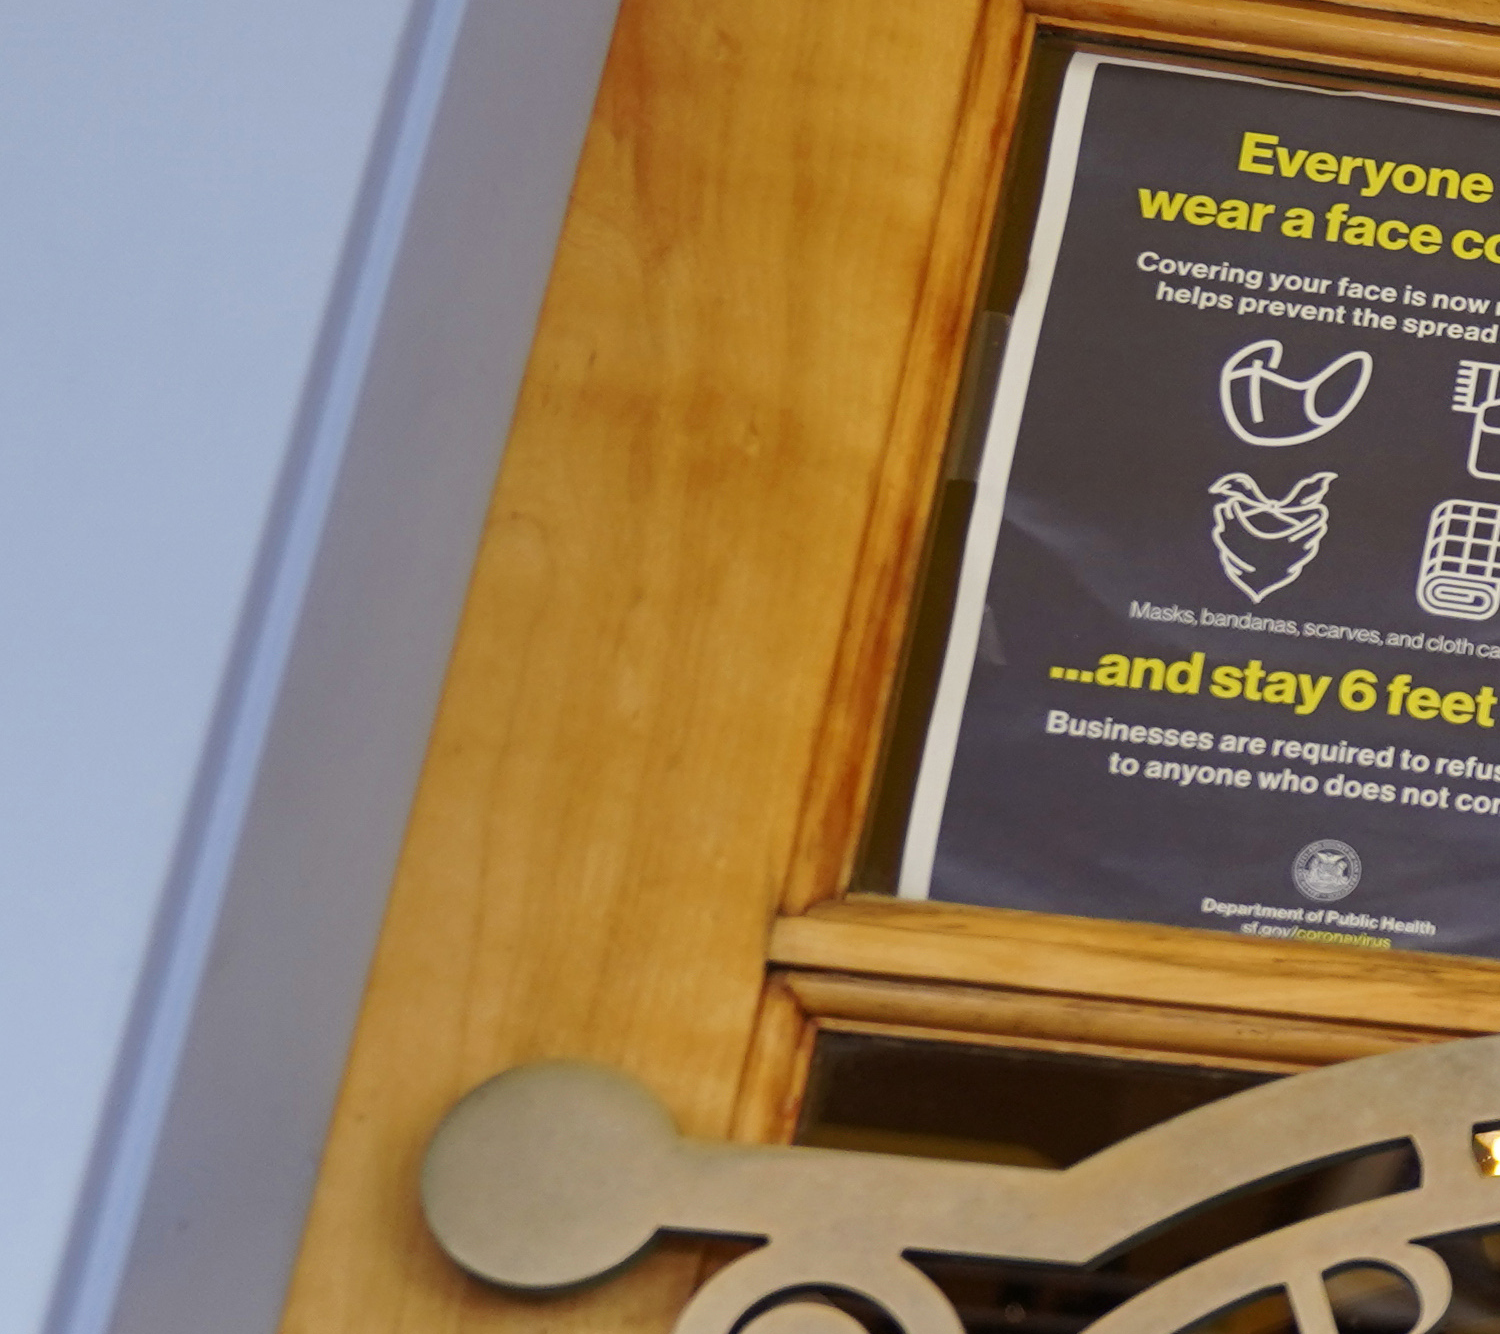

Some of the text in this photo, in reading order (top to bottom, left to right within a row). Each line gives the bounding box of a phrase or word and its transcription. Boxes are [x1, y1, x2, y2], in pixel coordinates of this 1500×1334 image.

[1237, 131, 1495, 204] Everyone
[1137, 187, 1277, 233] wear
[1280, 206, 1316, 240] a
[1324, 202, 1444, 255] face
[1136, 250, 1264, 290] Covering
[1267, 272, 1333, 295] your
[1337, 276, 1398, 304] face
[1402, 284, 1428, 308] is
[1431, 293, 1492, 315] now
[1155, 280, 1234, 310] helps
[1237, 296, 1347, 325] prevent
[1351, 307, 1398, 331] the
[1401, 317, 1500, 344] spread
[1128, 599, 1199, 627] Masks,
[1199, 607, 1301, 638] bandanas,
[1301, 621, 1385, 647] scarves,
[1384, 631, 1426, 650] and
[1424, 634, 1476, 656] cloth
[1049, 650, 1206, 695] ...and
[1208, 659, 1333, 716] stay
[1338, 668, 1379, 712] 6
[1386, 673, 1499, 728] feet
[1045, 709, 1215, 751] Businesses
[1217, 733, 1268, 756] are
[1270, 739, 1396, 769] required
[1399, 748, 1431, 774] to
[1108, 752, 1141, 777] to
[1143, 759, 1253, 788] anyone
[1257, 767, 1320, 795] who
[1322, 773, 1397, 803] does
[1400, 786, 1451, 810] not
[1200, 896, 1437, 938] Department of Public Health
